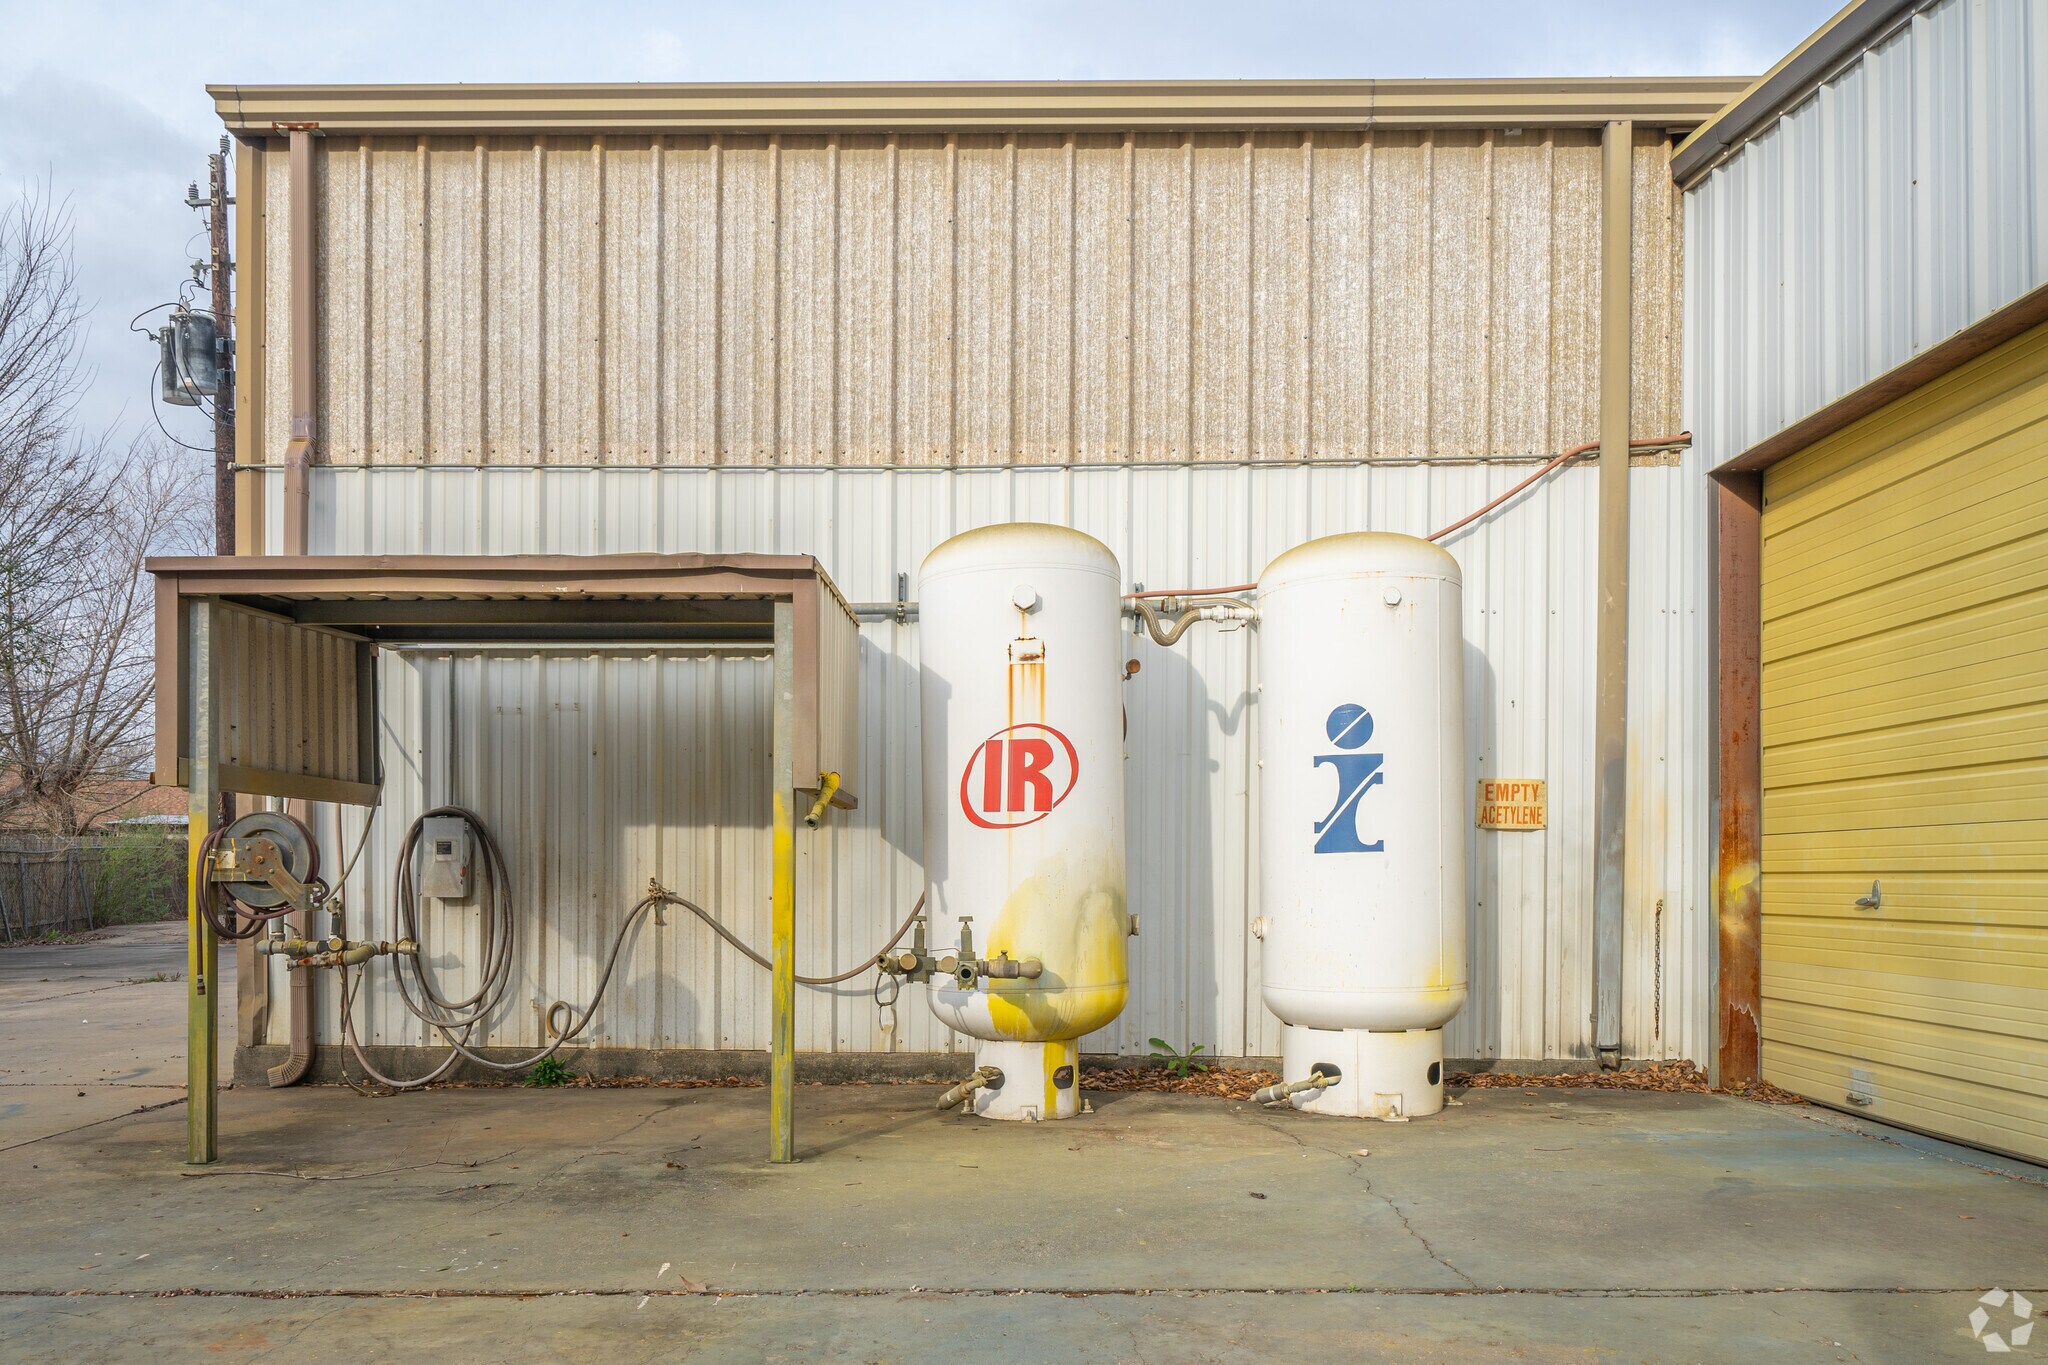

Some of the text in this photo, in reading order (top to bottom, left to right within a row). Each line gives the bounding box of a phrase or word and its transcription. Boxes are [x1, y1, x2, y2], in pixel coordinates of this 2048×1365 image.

[983, 738, 1054, 812] IR
[1485, 783, 1539, 802] EMPTY
[1481, 805, 1543, 825] ACETYLENE
